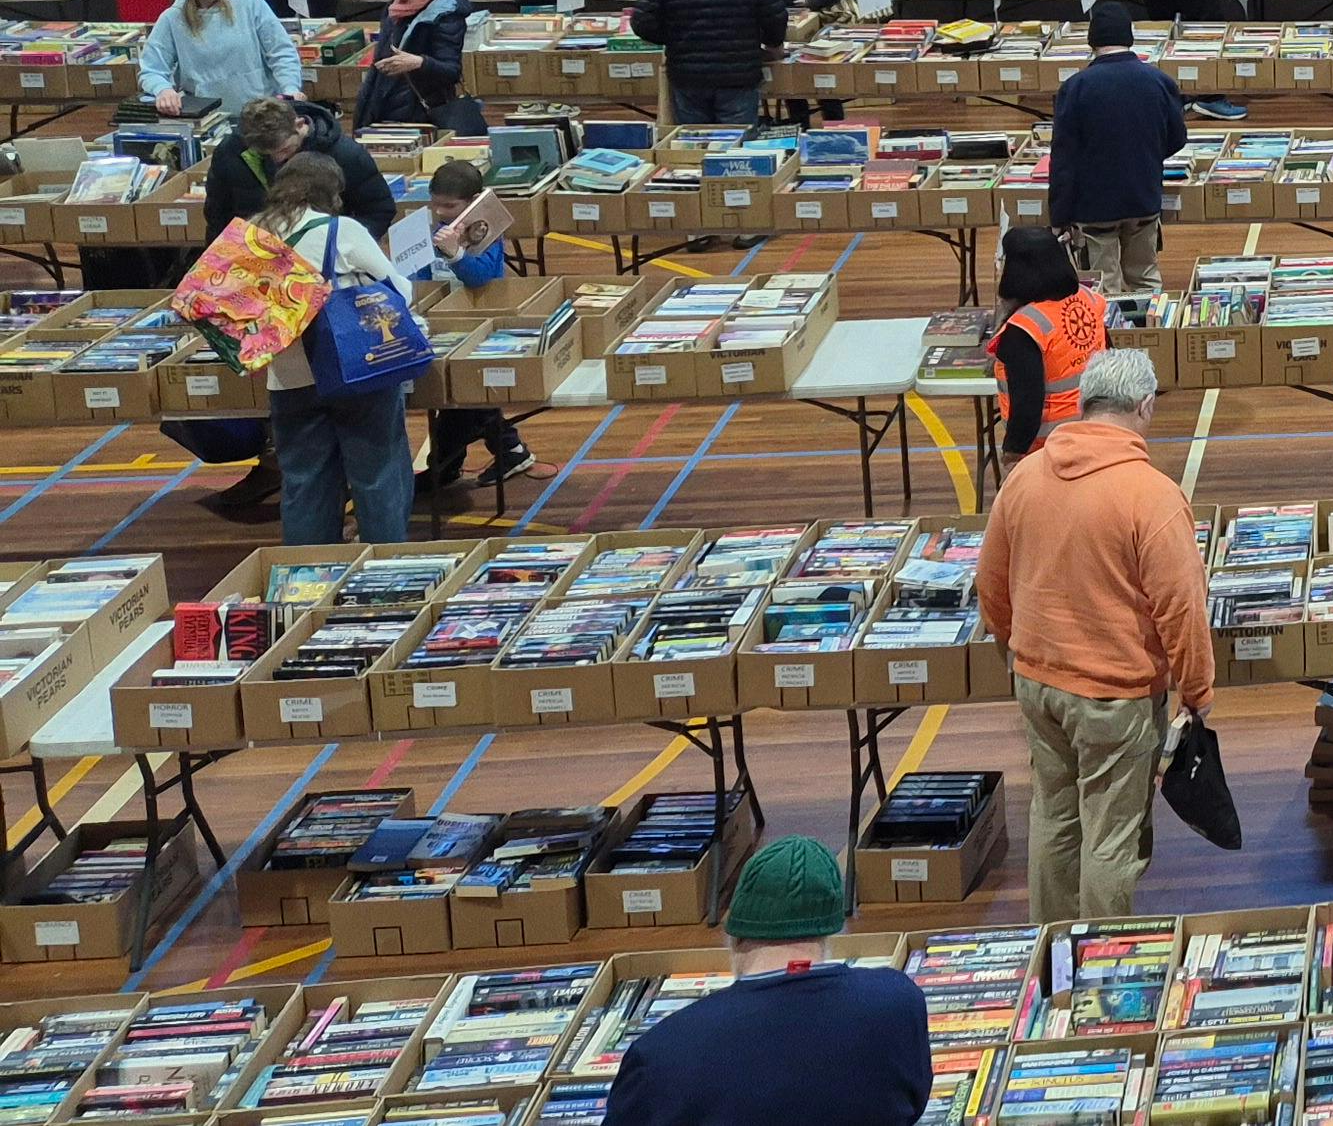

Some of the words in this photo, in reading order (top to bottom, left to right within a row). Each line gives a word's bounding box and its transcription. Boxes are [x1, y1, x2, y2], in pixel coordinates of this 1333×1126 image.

[394, 237, 428, 266] WESTERNS
[109, 582, 150, 626] VICTORIAN
[118, 601, 145, 634] PEARS
[230, 610, 257, 658] KING
[1216, 625, 1284, 638] VICTORIAN
[25, 653, 73, 703] VICTORIAN
[37, 674, 67, 710] PEARS
[285, 699, 313, 707] CRIME
